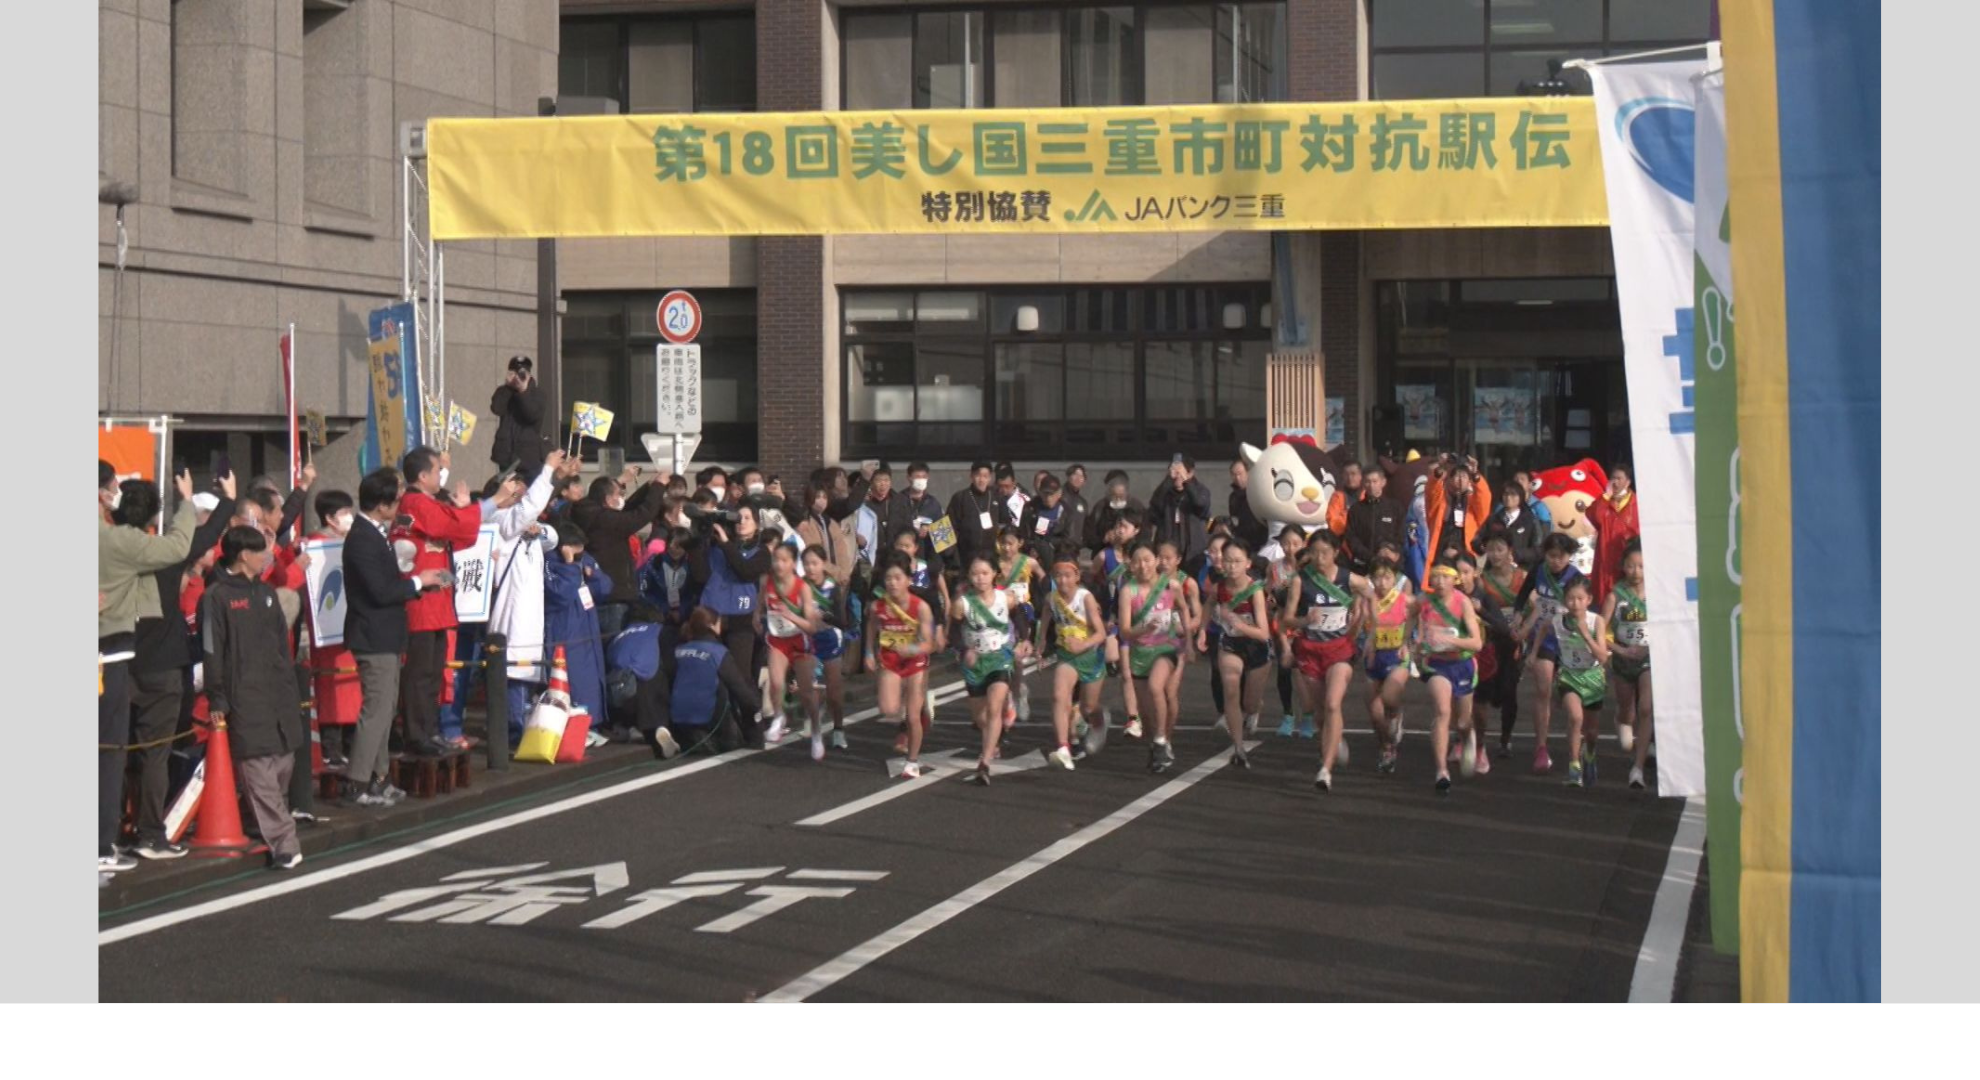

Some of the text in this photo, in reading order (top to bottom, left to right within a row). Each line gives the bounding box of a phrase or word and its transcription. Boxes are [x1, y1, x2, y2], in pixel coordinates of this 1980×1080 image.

[653, 110, 1572, 182] 第18回美し国三重市町対抗駅伝
[920, 189, 1051, 223] 特別協賛
[1125, 192, 1285, 222] JAバンク三重
[686, 348, 697, 416] トラックなどの
[329, 860, 892, 933] 徐行
